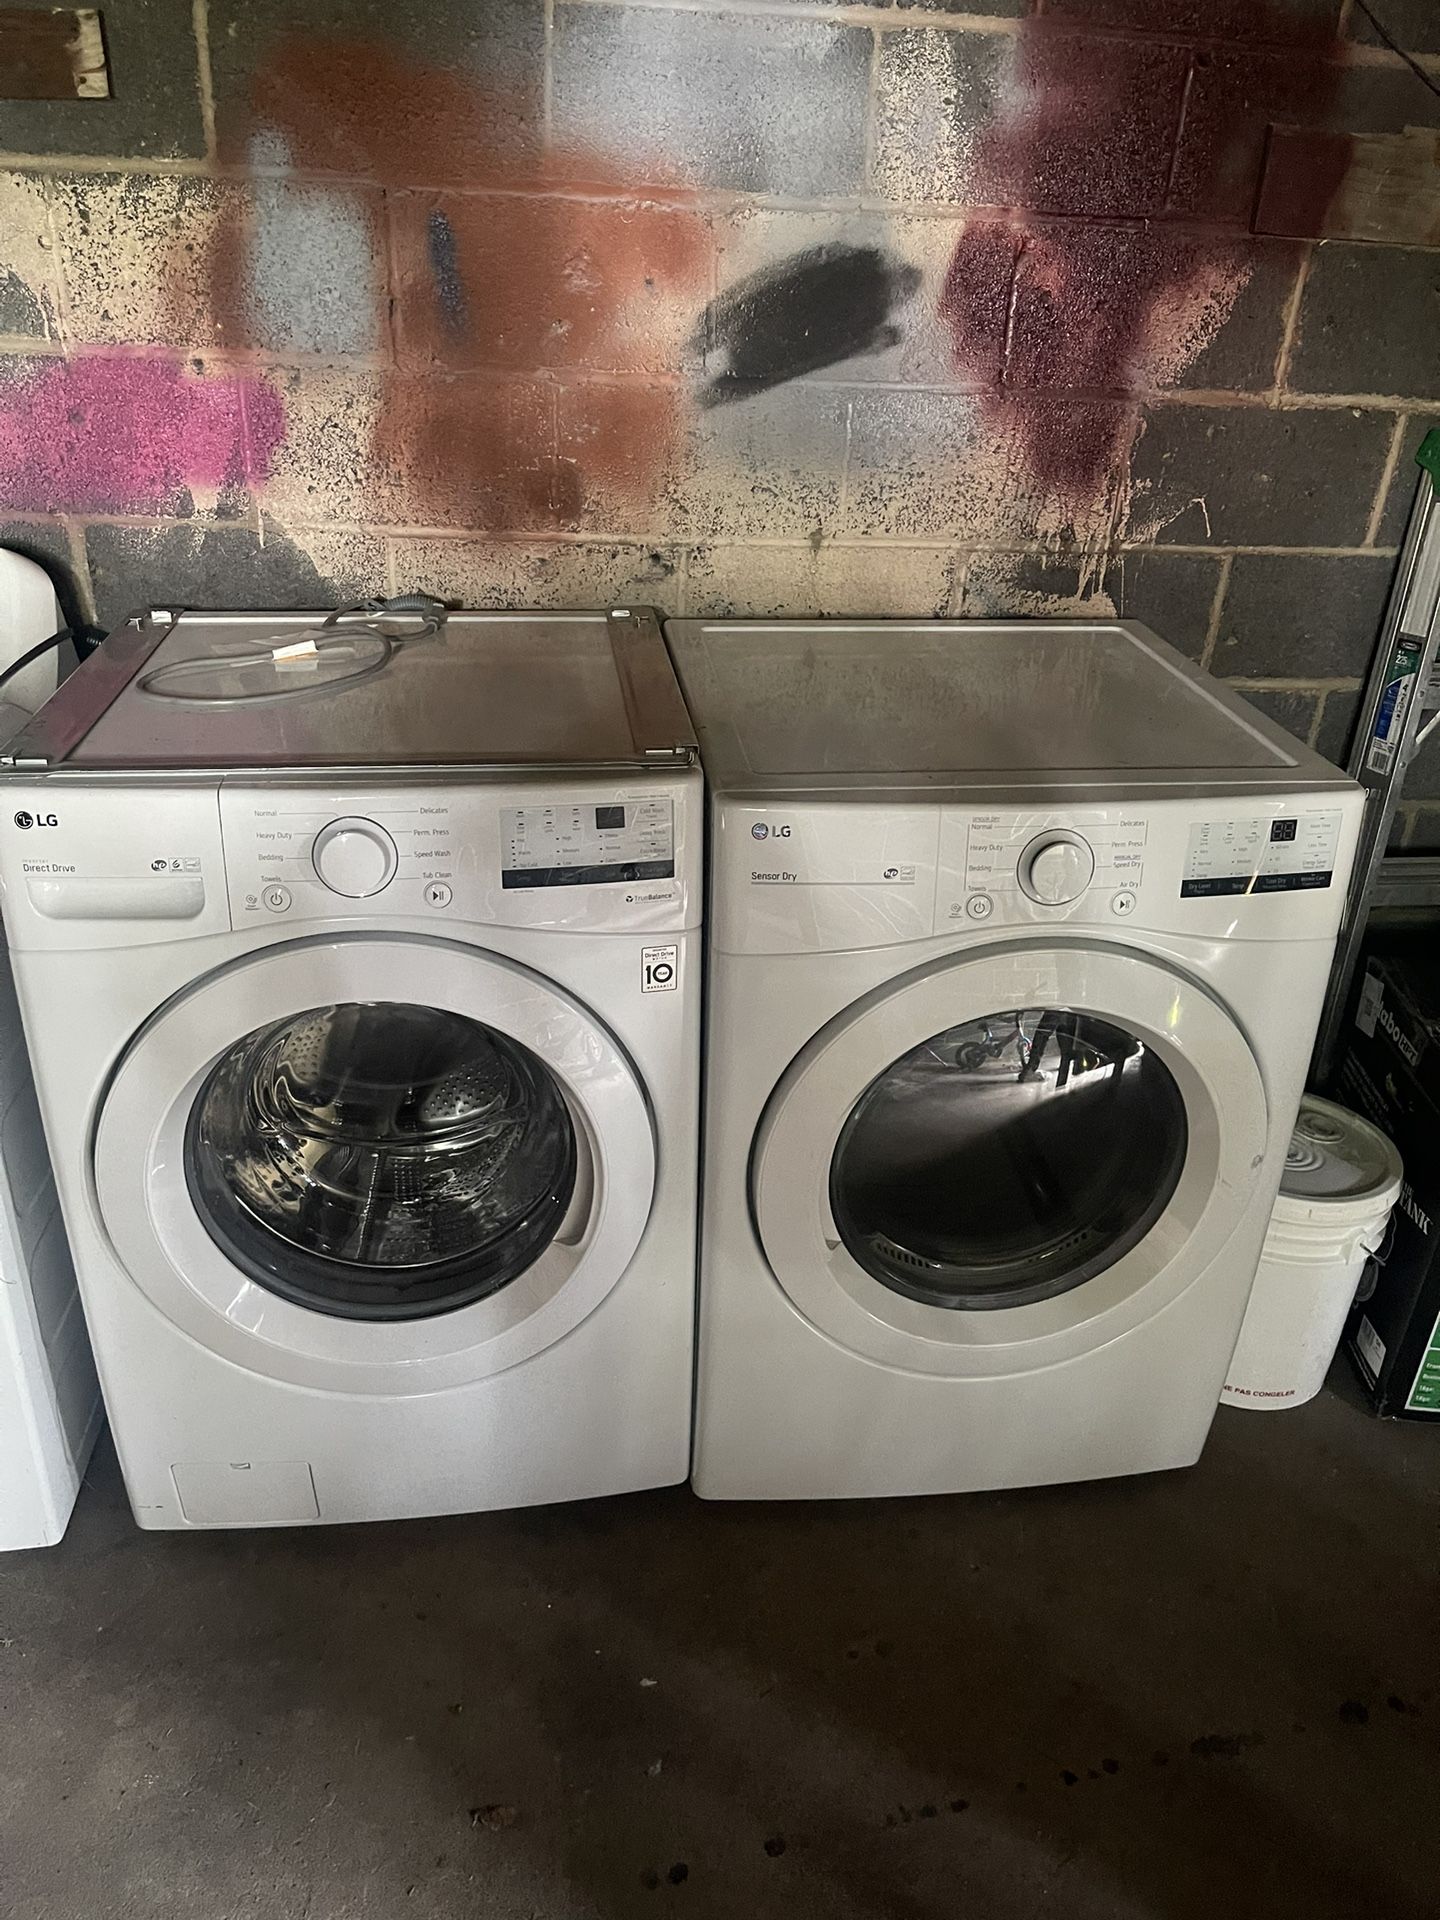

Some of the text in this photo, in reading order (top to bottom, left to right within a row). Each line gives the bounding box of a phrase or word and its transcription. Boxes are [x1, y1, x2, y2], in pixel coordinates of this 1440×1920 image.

[254, 809, 278, 817] Normal
[36, 814, 58, 827] LG
[772, 825, 791, 838] LG
[256, 832, 292, 840] Heavy Duty
[257, 853, 285, 862] Bedding
[414, 850, 433, 858] Speed
[22, 863, 76, 873] Direct Drive
[968, 864, 992, 872] Bedding
[1131, 861, 1141, 869] Dry
[260, 875, 282, 883] Towels
[435, 871, 453, 879] Clean
[751, 871, 798, 882] Sensor Dry
[1119, 880, 1139, 889] Air Dry
[646, 963, 673, 985] 10
[1234, 1388, 1251, 1396] PAS
